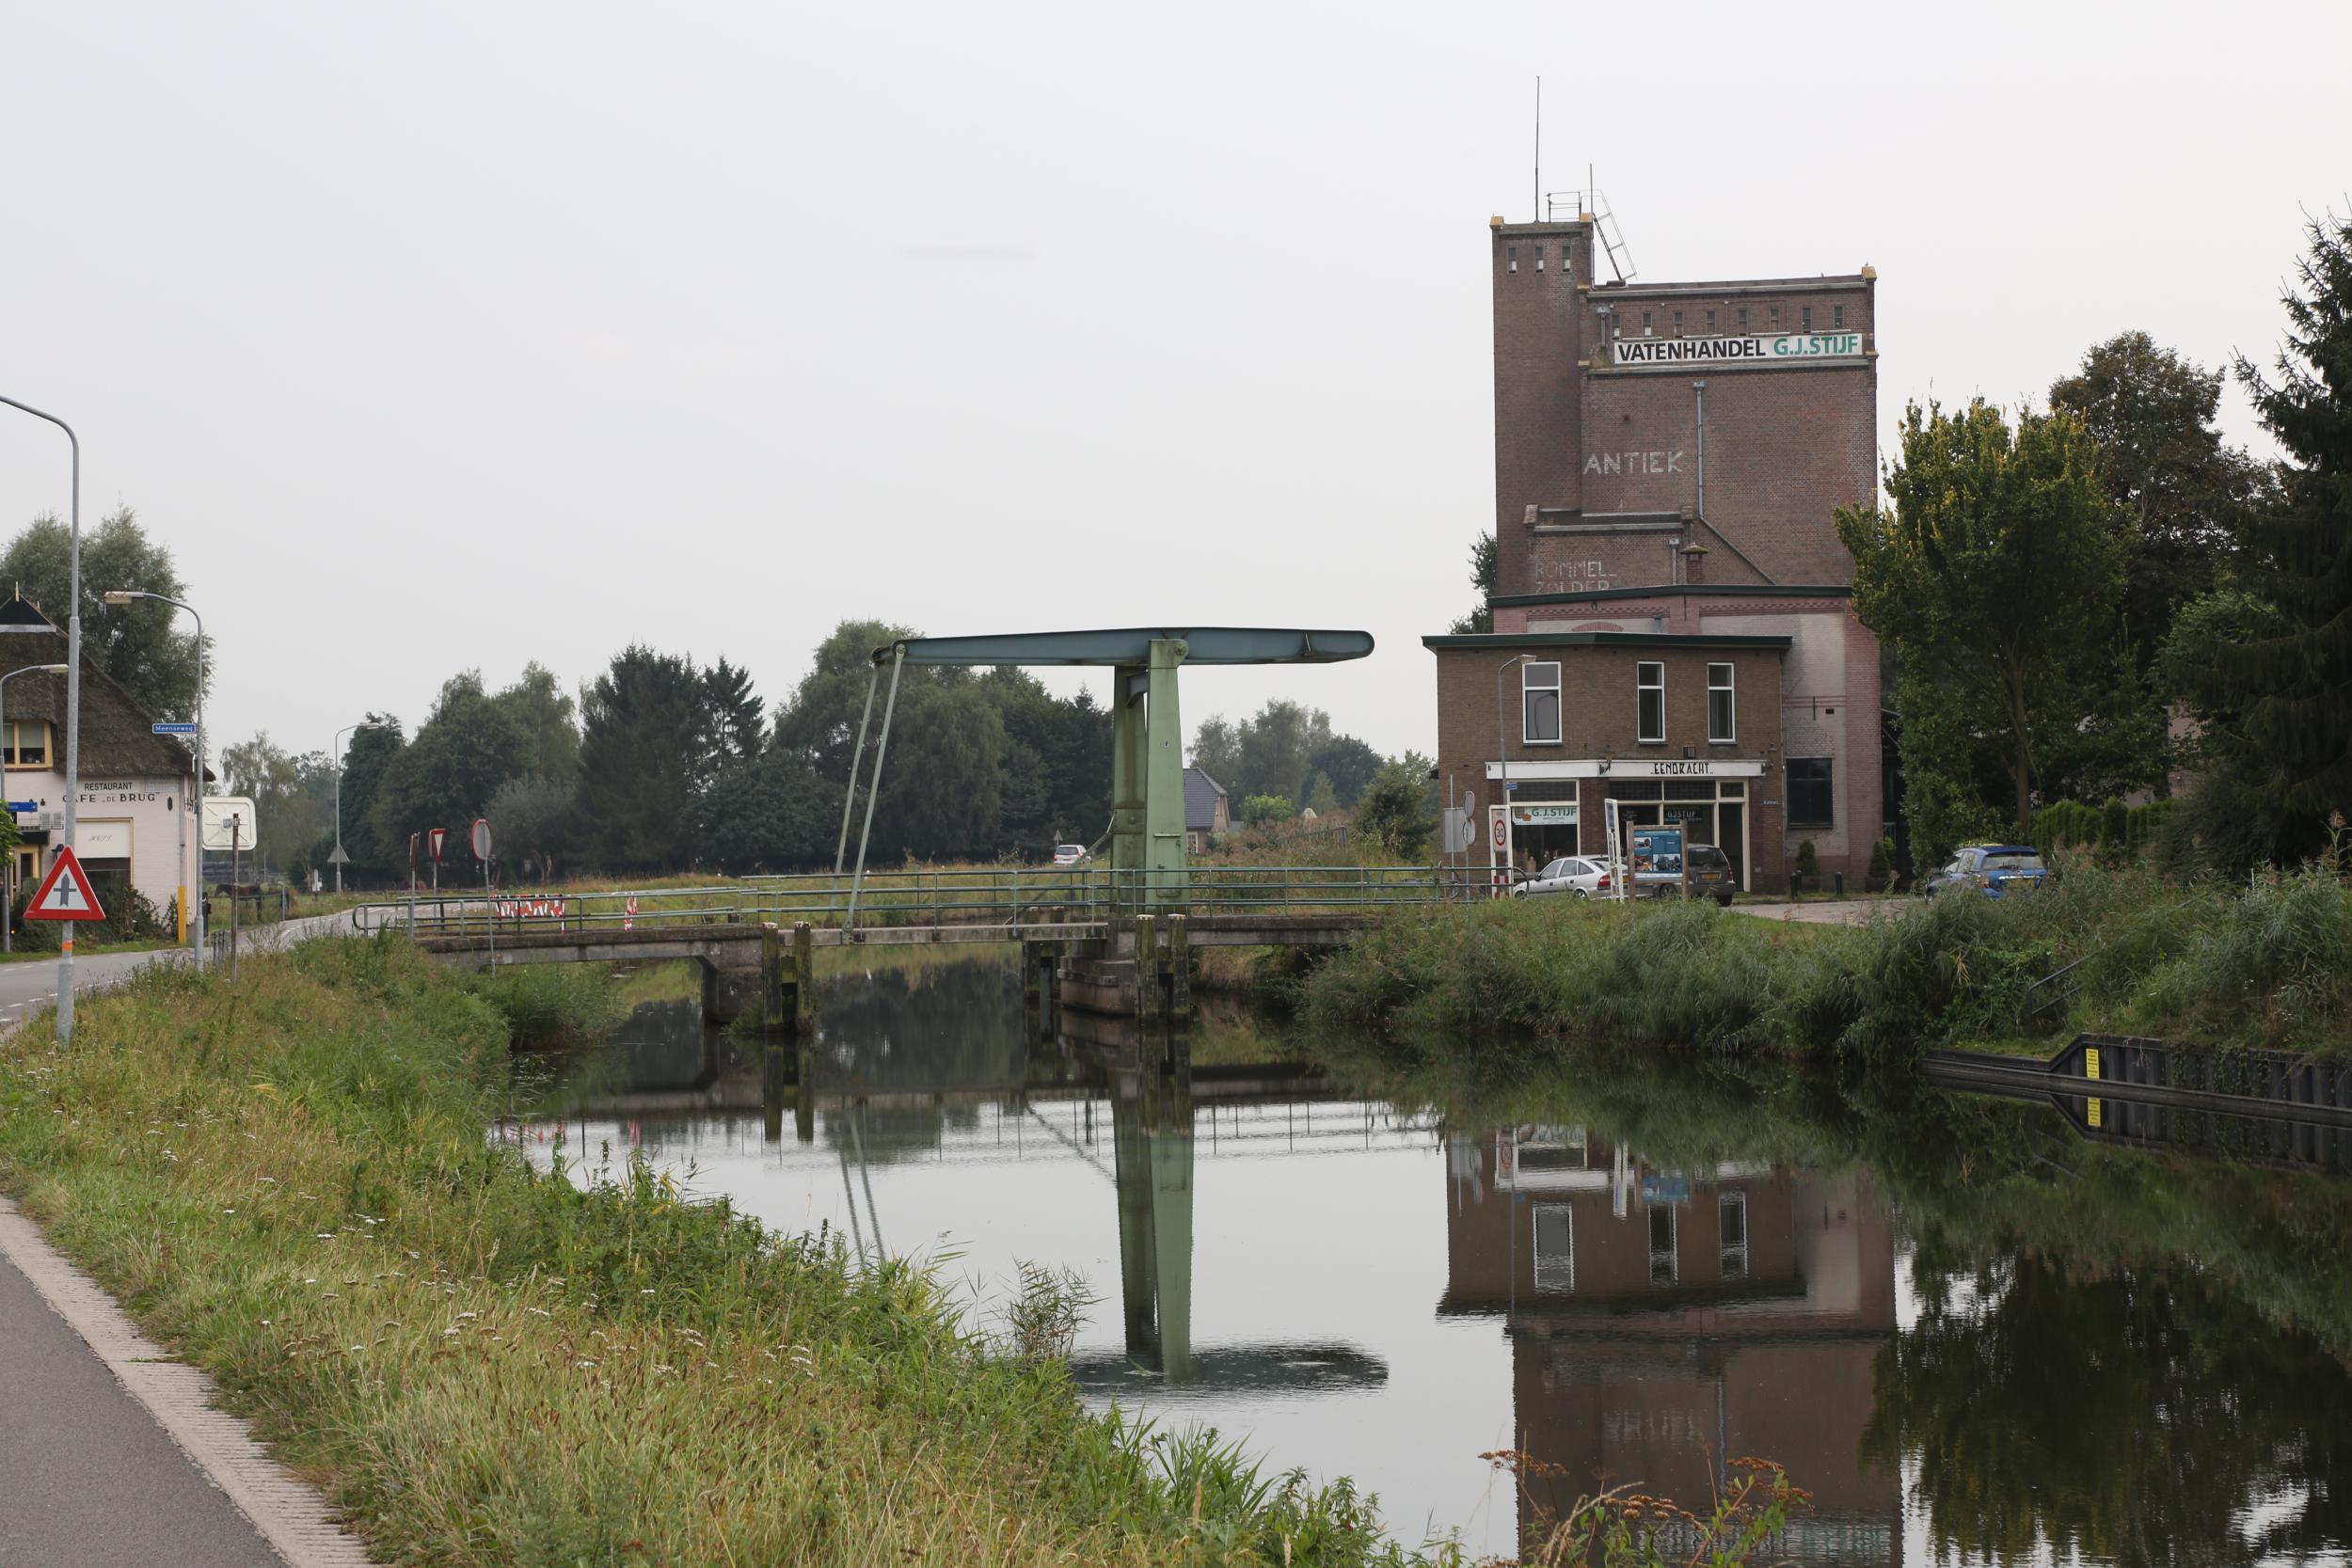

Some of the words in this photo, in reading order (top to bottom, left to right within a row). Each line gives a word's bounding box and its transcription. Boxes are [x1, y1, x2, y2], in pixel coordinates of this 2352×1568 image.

[1618, 340, 1766, 361] VATENHANDEL
[1773, 336, 1858, 356] G.J.STIJF
[1582, 451, 1684, 474] ANTIEK
[62, 794, 97, 802] CFE
[1496, 828, 1504, 838] 30
